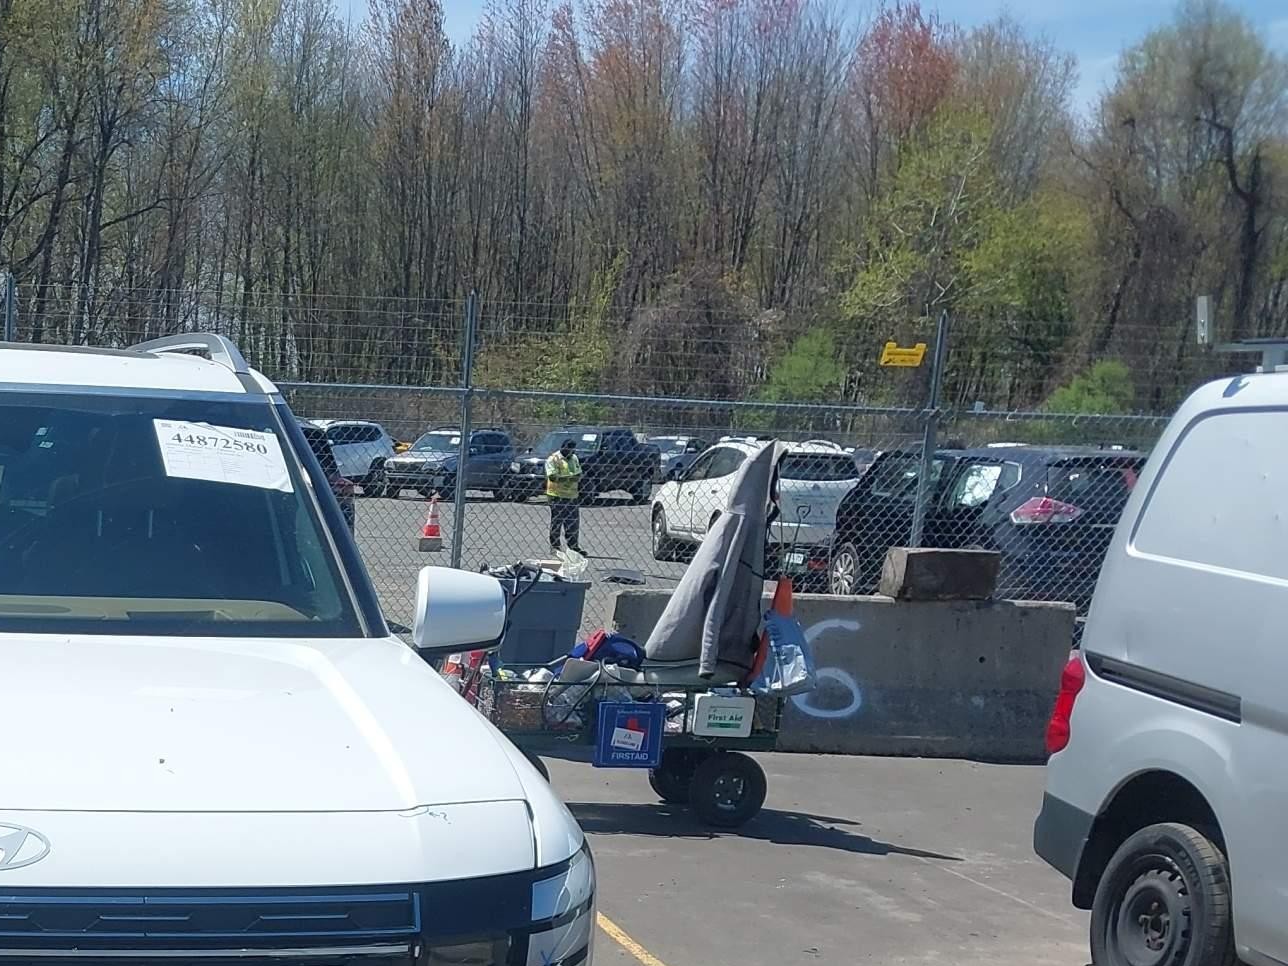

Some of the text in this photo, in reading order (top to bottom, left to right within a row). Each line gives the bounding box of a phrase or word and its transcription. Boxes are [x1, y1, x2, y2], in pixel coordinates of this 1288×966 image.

[171, 433, 268, 455] 44872580
[791, 618, 862, 718] 6
[708, 713, 726, 721] First
